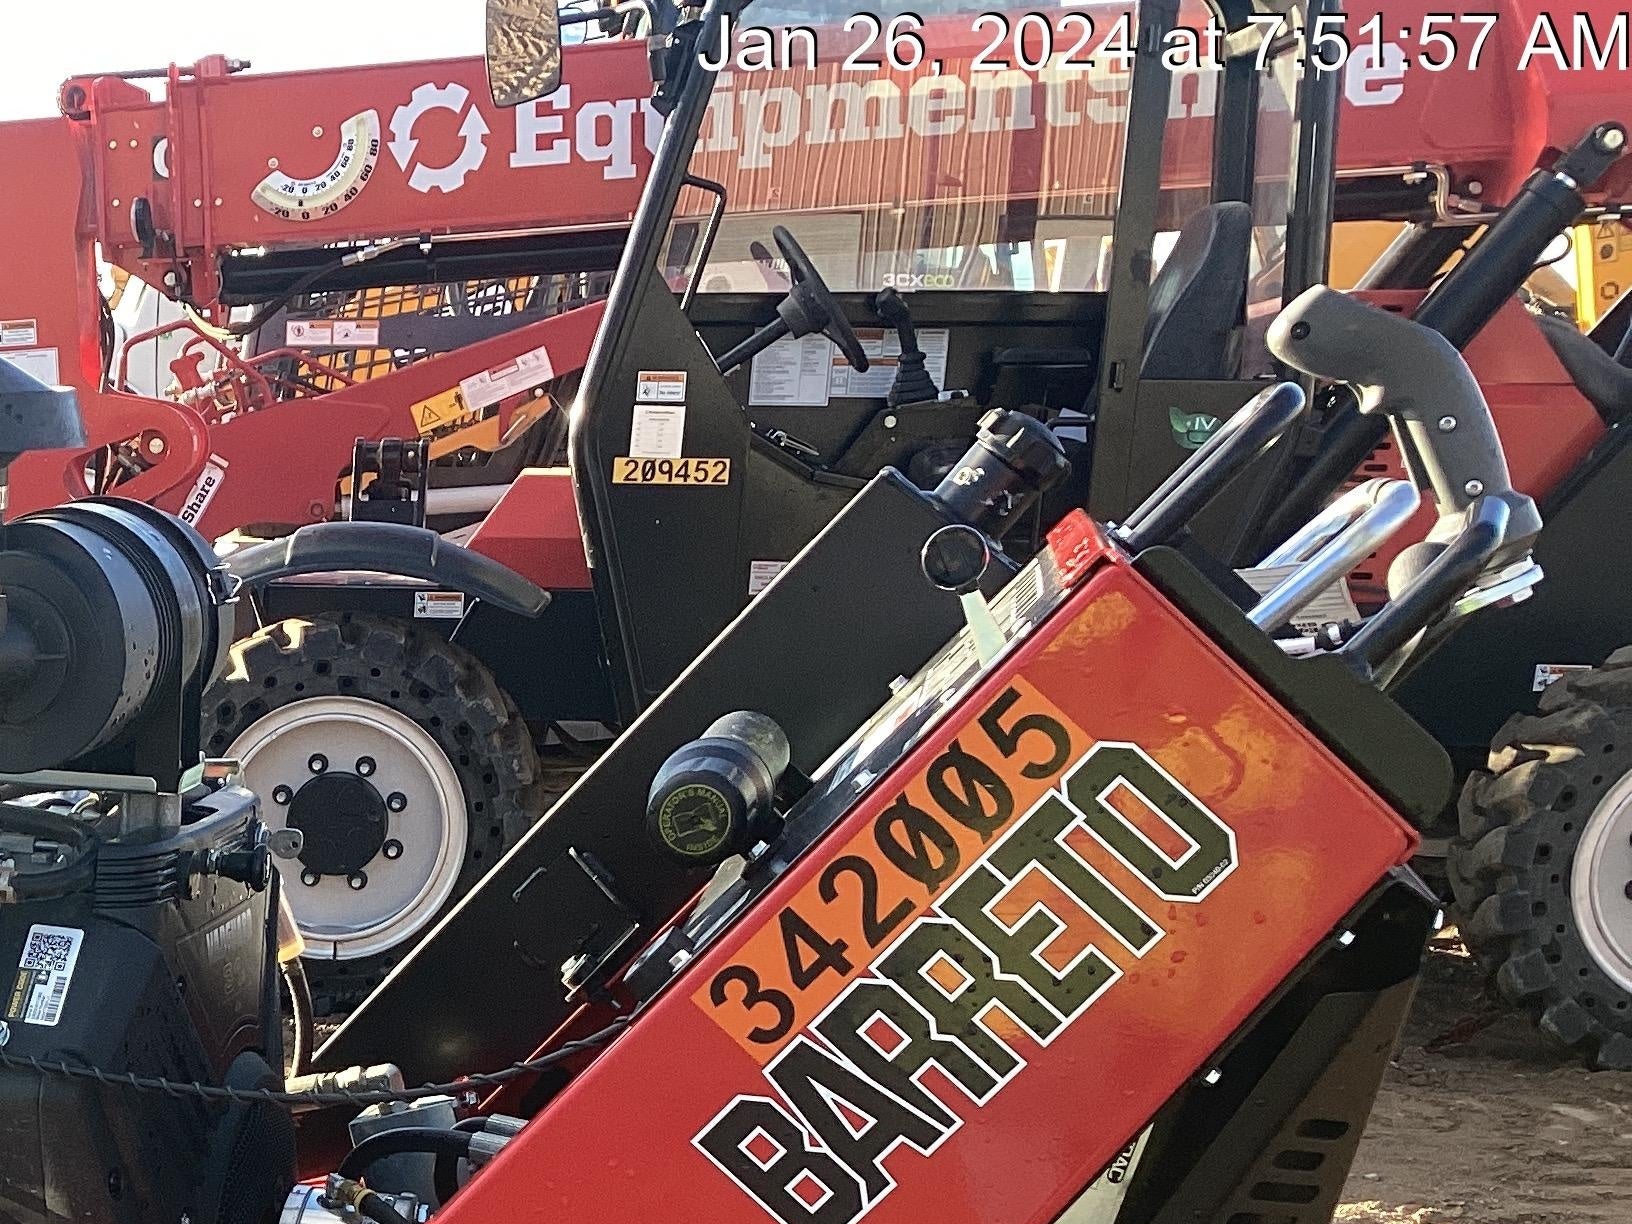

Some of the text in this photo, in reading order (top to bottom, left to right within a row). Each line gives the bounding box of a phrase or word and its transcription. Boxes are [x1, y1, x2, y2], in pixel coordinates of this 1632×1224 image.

[301, 211, 310, 220] 0
[322, 202, 338, 215] 20
[344, 187, 359, 202] 40
[360, 164, 373, 181] 60
[369, 139, 379, 156] 80
[181, 476, 216, 523] Share
[622, 459, 728, 482] 209452
[709, 686, 1071, 1046] 342005
